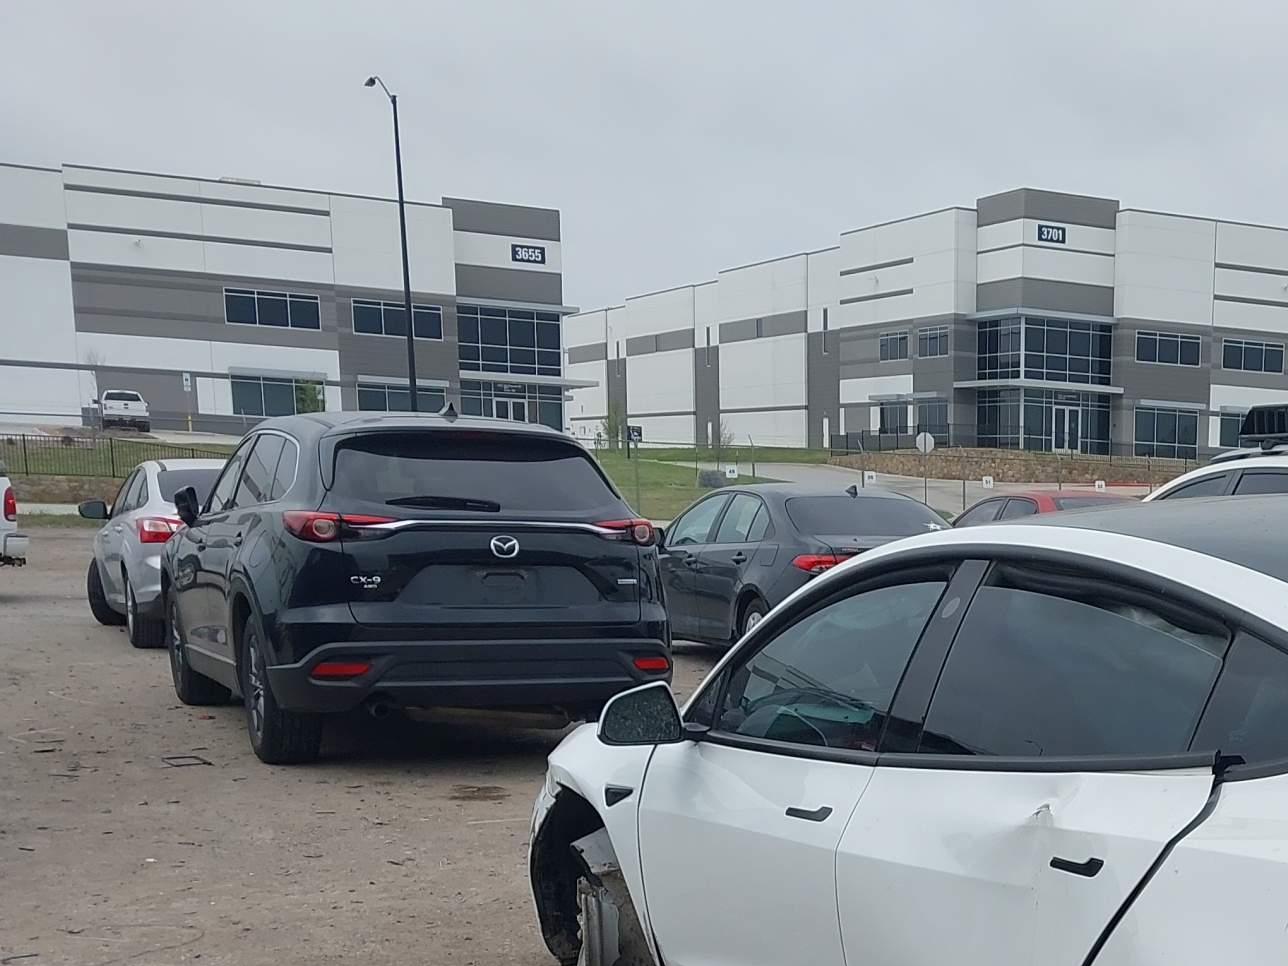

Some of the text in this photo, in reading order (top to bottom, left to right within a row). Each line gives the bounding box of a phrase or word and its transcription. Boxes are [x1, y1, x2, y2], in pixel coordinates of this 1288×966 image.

[1041, 227, 1063, 241] 3701
[515, 247, 542, 261] 3655
[350, 576, 381, 584] CX-9
